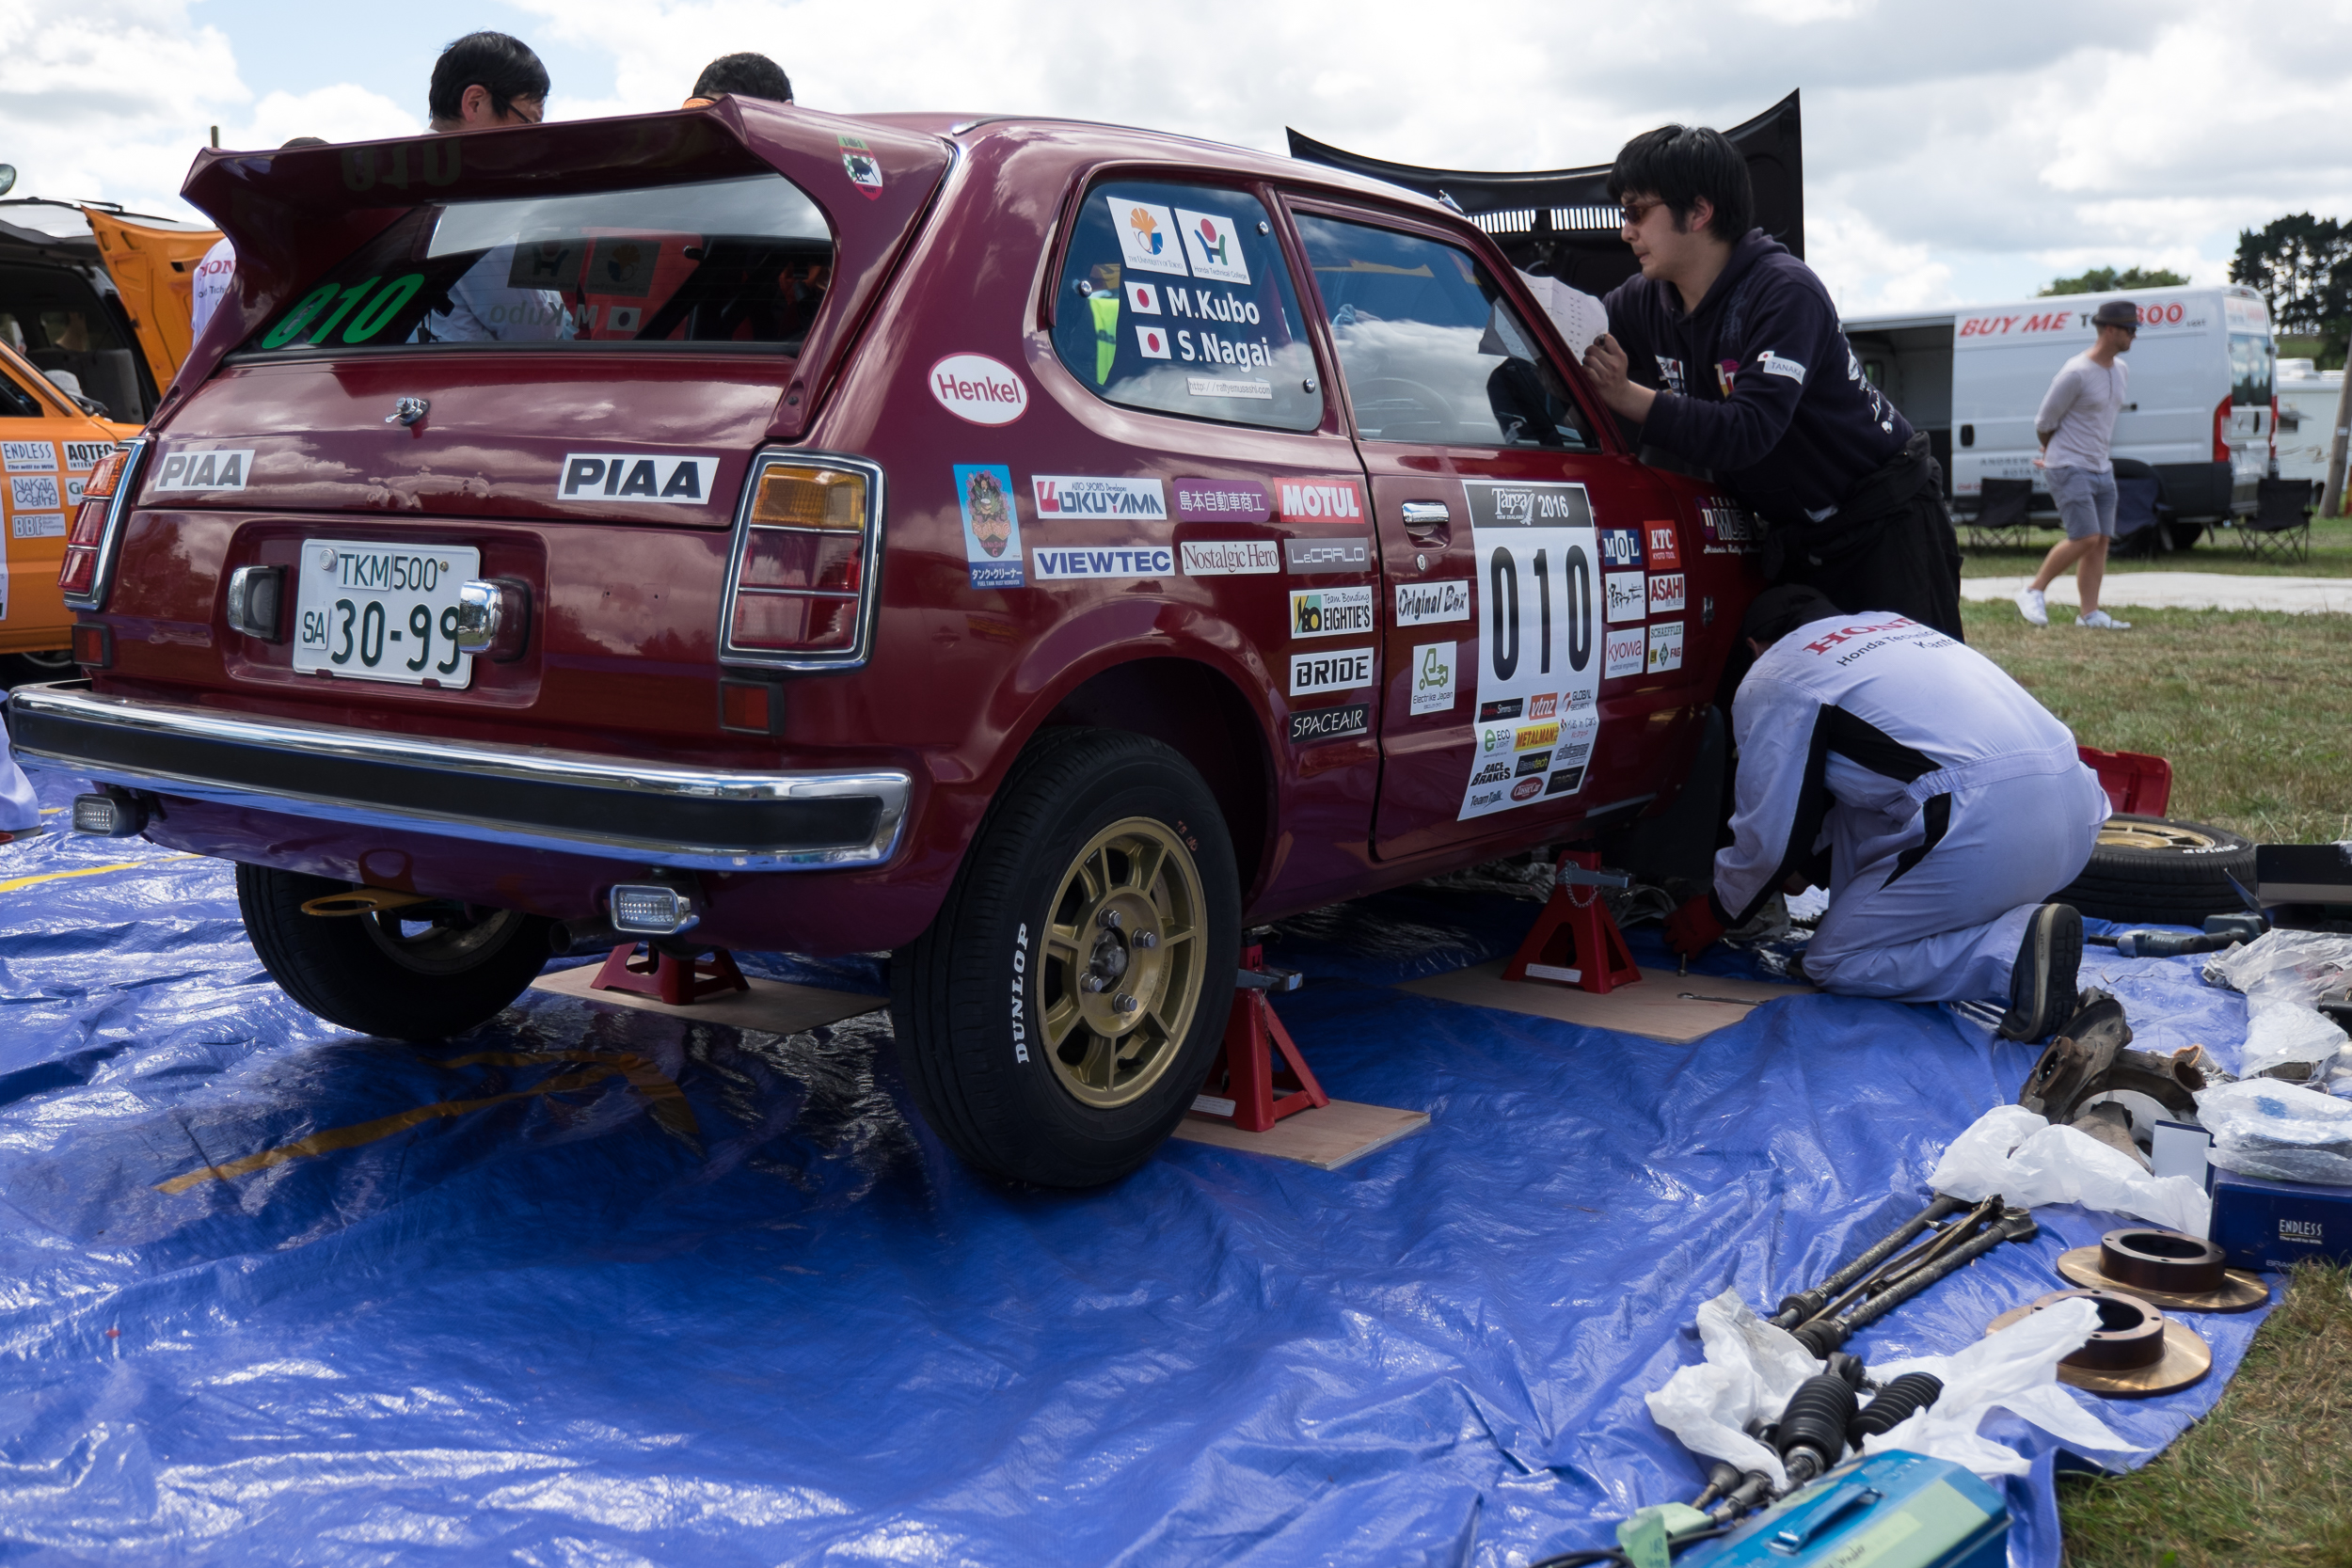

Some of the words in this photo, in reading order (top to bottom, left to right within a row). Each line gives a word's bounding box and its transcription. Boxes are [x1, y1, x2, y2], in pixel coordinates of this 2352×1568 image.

[1194, 265, 1209, 274] Honda
[1209, 268, 1231, 277] Technical
[1231, 271, 1248, 280] College
[262, 274, 425, 349] 010
[1166, 286, 1260, 325] M.Kubo
[1959, 315, 2021, 337] BUY
[2022, 311, 2072, 334] ME
[1177, 330, 1272, 372] S.Nagai
[936, 373, 1022, 404] Henkel
[3, 443, 52, 459] ENDLESS
[158, 454, 243, 486] PIAA
[564, 458, 702, 499] PIAA
[15, 490, 57, 507] Coating
[1179, 490, 1265, 513] 島本自動車商工
[1282, 484, 1359, 517] MOTUL
[1492, 488, 1527, 515] Targa
[1538, 495, 1569, 518] 2016
[1603, 537, 1640, 558] MOL
[1650, 529, 1674, 549] KTC
[1038, 551, 1170, 574] VIEWTEC
[1183, 543, 1245, 573] Nostalgic
[1247, 544, 1279, 567] Hero
[972, 568, 1023, 580] タンク・クリーナー
[1323, 594, 1341, 604] Team
[1342, 592, 1369, 603] Bonding
[1650, 577, 1683, 602] ASAHI
[1398, 586, 1442, 621] Original
[1443, 585, 1468, 612] Box
[1490, 545, 1592, 681] 010
[304, 611, 326, 645] SA
[1324, 605, 1370, 631] EIGHTIE'S
[331, 598, 460, 674] 30-99
[1650, 626, 1682, 639] SCHAEFFLER
[1608, 638, 1642, 662] kyowa
[1670, 647, 1681, 658] FAG
[1836, 640, 1886, 667] Honda
[1295, 656, 1370, 688] BRIDE
[1531, 697, 1556, 718] vtnz
[1572, 689, 1592, 702] GLOBAL
[1293, 709, 1363, 737] SPACEAIR
[1497, 729, 1511, 741] ECO
[1516, 726, 1555, 749] METALMAN
[1470, 768, 1511, 786] BRAKES
[1483, 762, 1504, 774] RACE
[1012, 923, 1030, 1064] DUNLOP
[2280, 1219, 2322, 1236] ENDLESS
